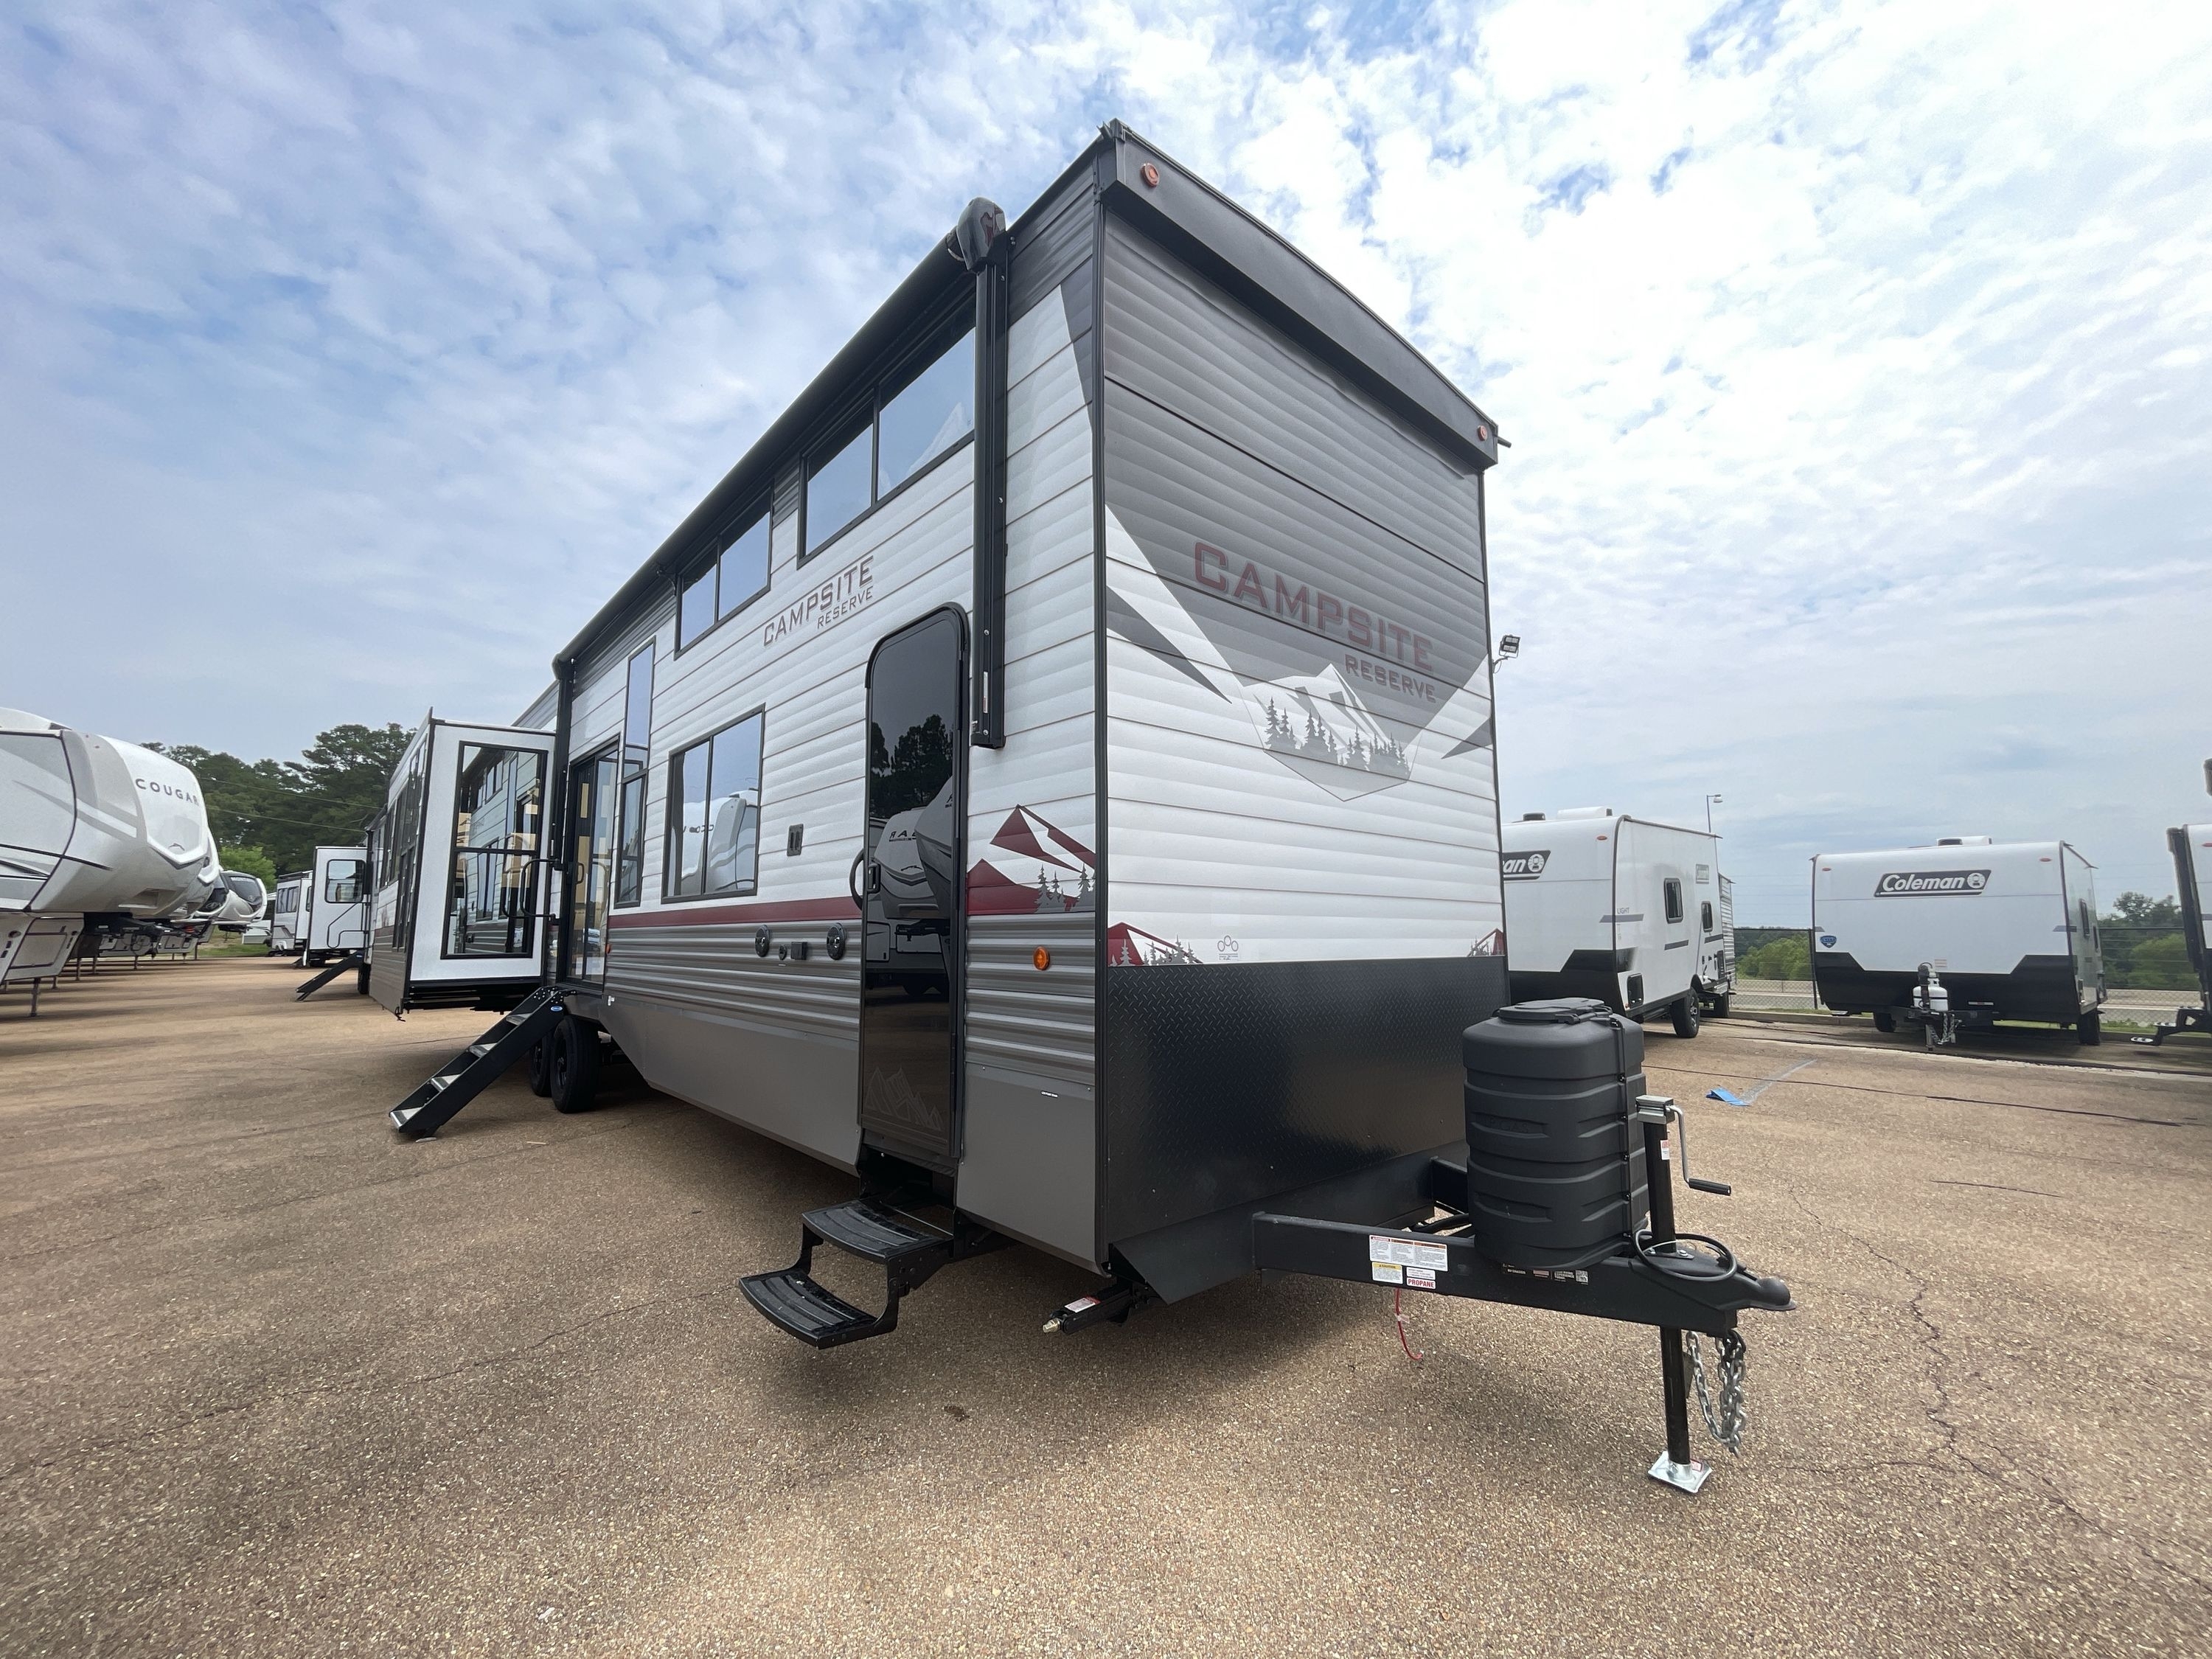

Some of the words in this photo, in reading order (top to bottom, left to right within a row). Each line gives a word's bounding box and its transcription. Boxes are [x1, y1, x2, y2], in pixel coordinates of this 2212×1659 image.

[763, 555, 874, 647] CAMPSITE
[817, 585, 874, 629] RESERVE
[1194, 542, 1434, 672] CAMPSITE
[1344, 653, 1436, 703] RESERVE
[135, 778, 200, 807] COUGAR
[1882, 874, 1966, 891] Coleman
[1408, 1279, 1434, 1288] PROPANE
